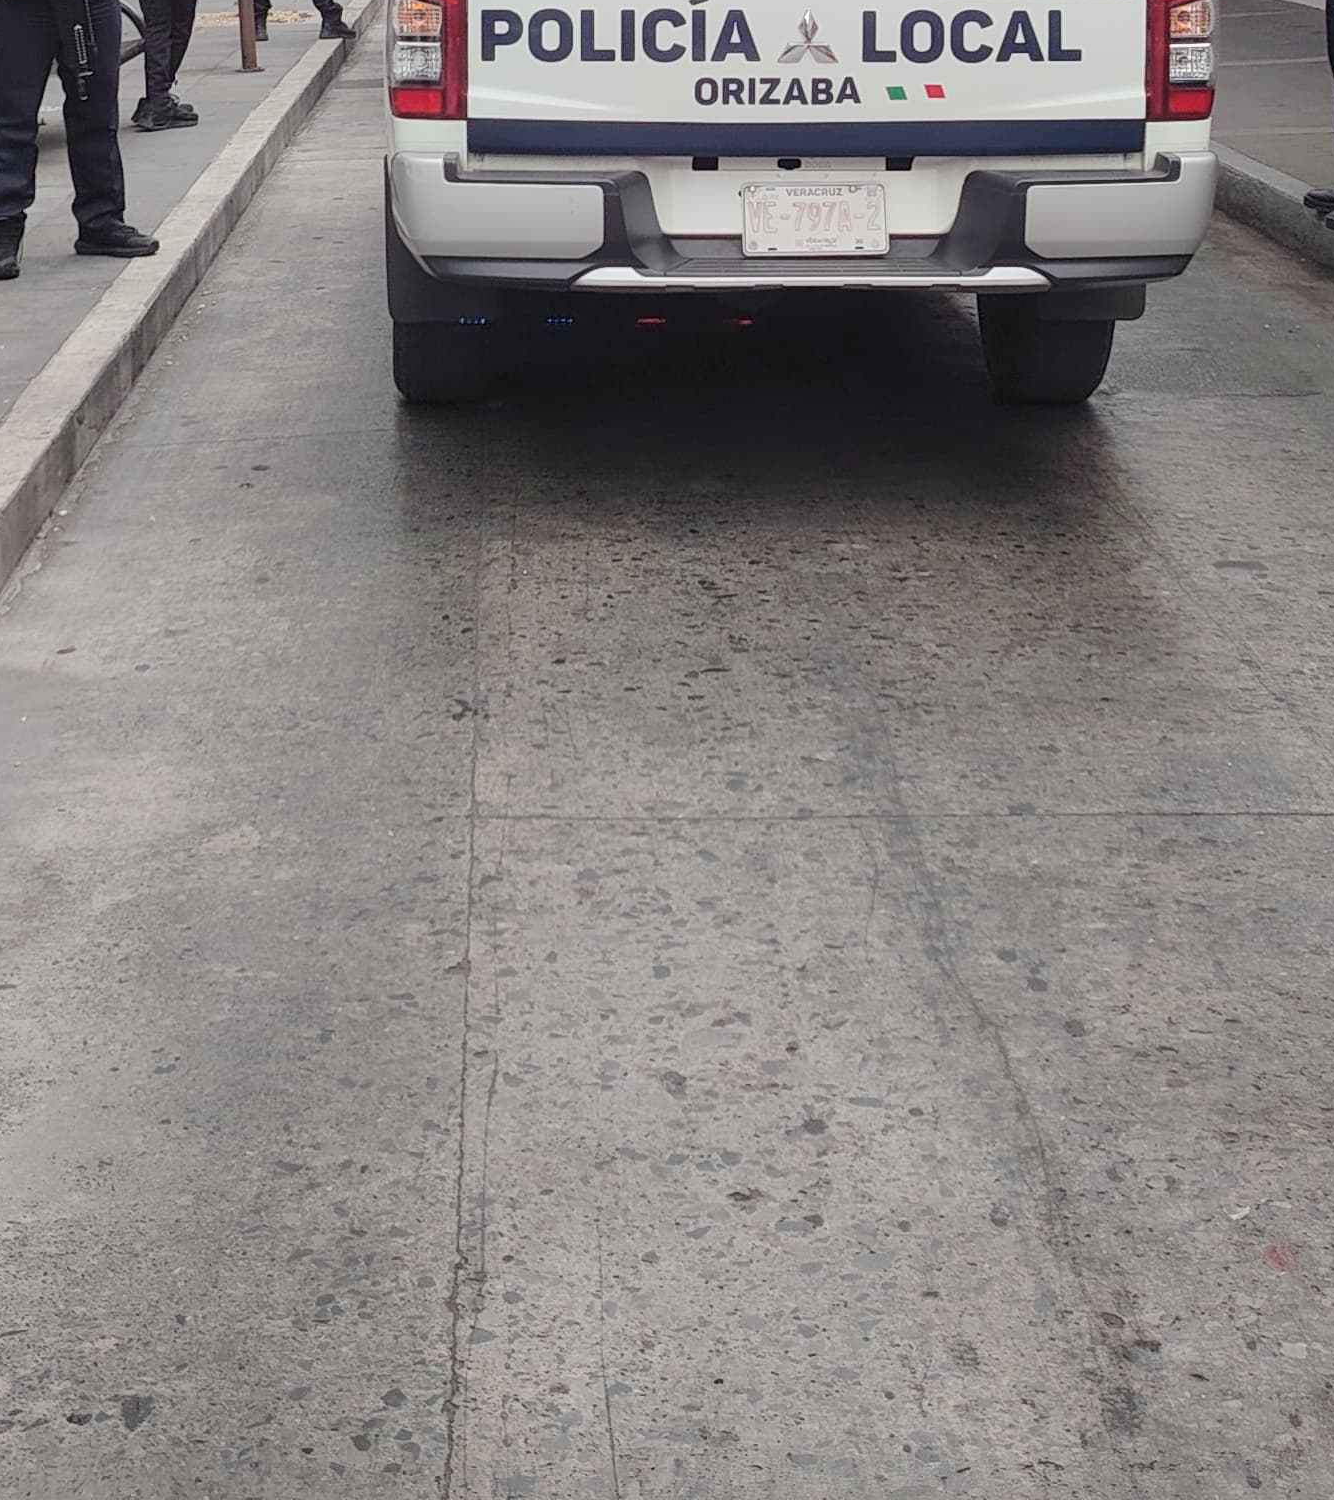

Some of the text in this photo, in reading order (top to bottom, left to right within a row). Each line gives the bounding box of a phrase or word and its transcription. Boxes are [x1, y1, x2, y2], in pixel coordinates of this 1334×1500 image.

[862, 9, 1083, 64] LOCAL
[694, 77, 862, 106] ORIZABA
[785, 187, 843, 197] VERACRUZ
[748, 201, 882, 234] VE-797A-2
